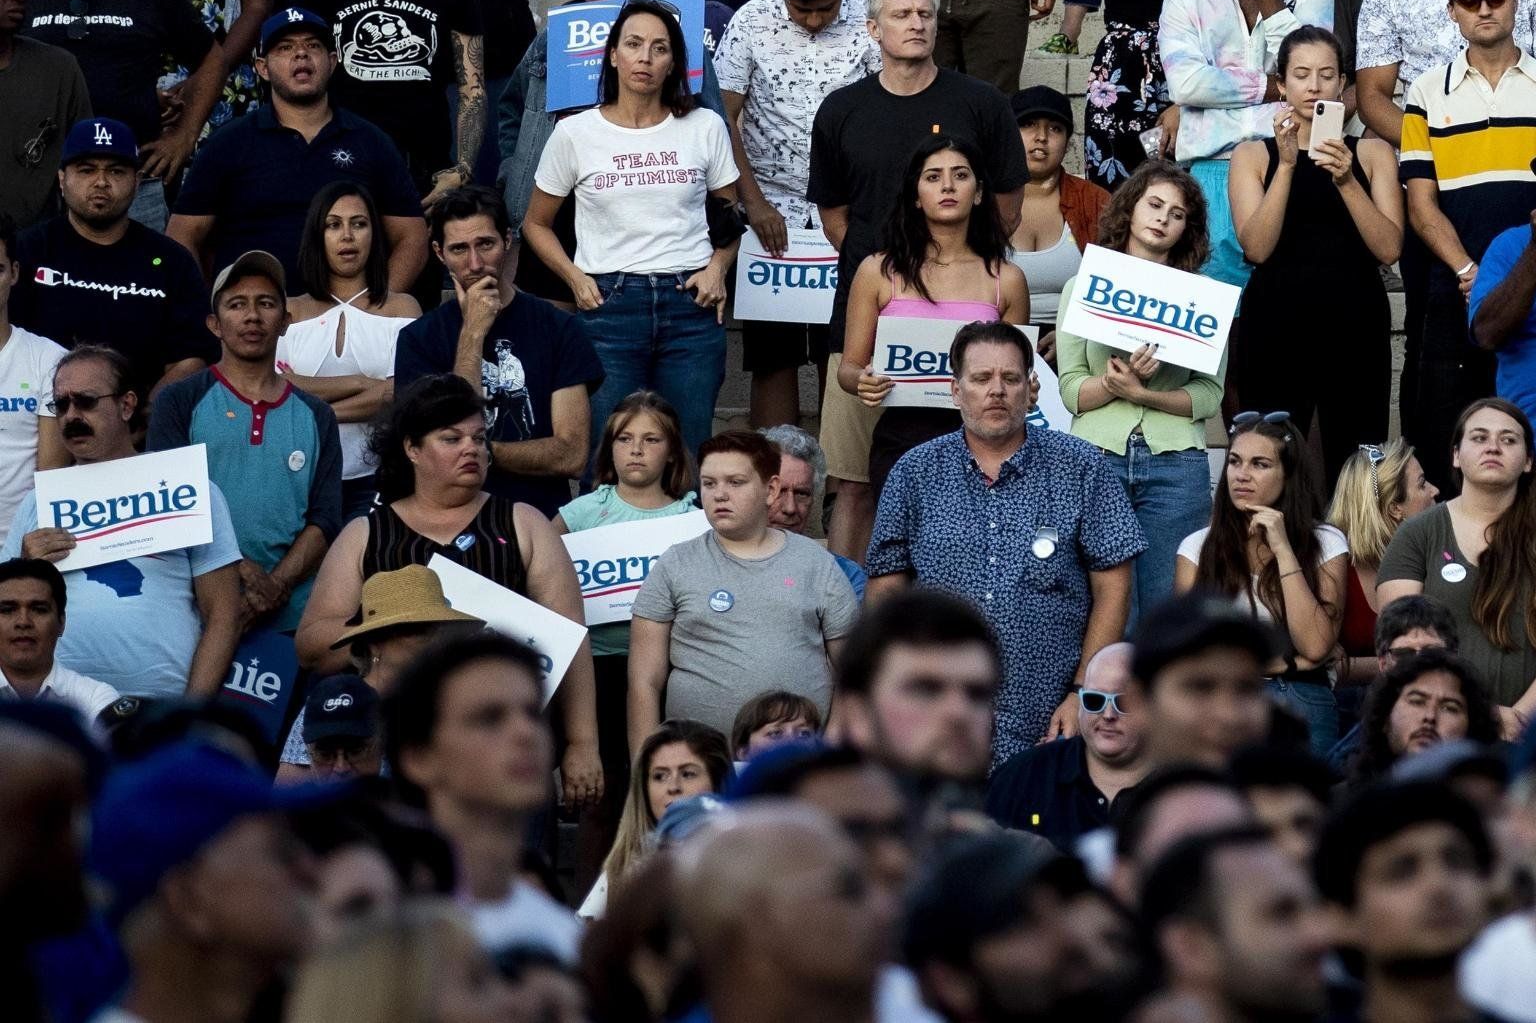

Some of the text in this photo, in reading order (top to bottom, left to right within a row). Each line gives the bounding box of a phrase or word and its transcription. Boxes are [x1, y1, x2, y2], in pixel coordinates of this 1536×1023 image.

[32, 14, 54, 28] got
[285, 7, 304, 23] LA
[350, 65, 364, 77] EAT
[370, 69, 389, 79] THE
[94, 122, 113, 146] LA
[613, 151, 679, 170] TEAM
[594, 169, 699, 190] OPTIMIST
[34, 266, 167, 301] Champion
[747, 261, 839, 296] rnie
[1082, 275, 1219, 339] Bernie
[883, 344, 955, 376] Ber
[0, 396, 38, 413] are
[50, 479, 198, 530] Bernie
[223, 657, 282, 703] nie
